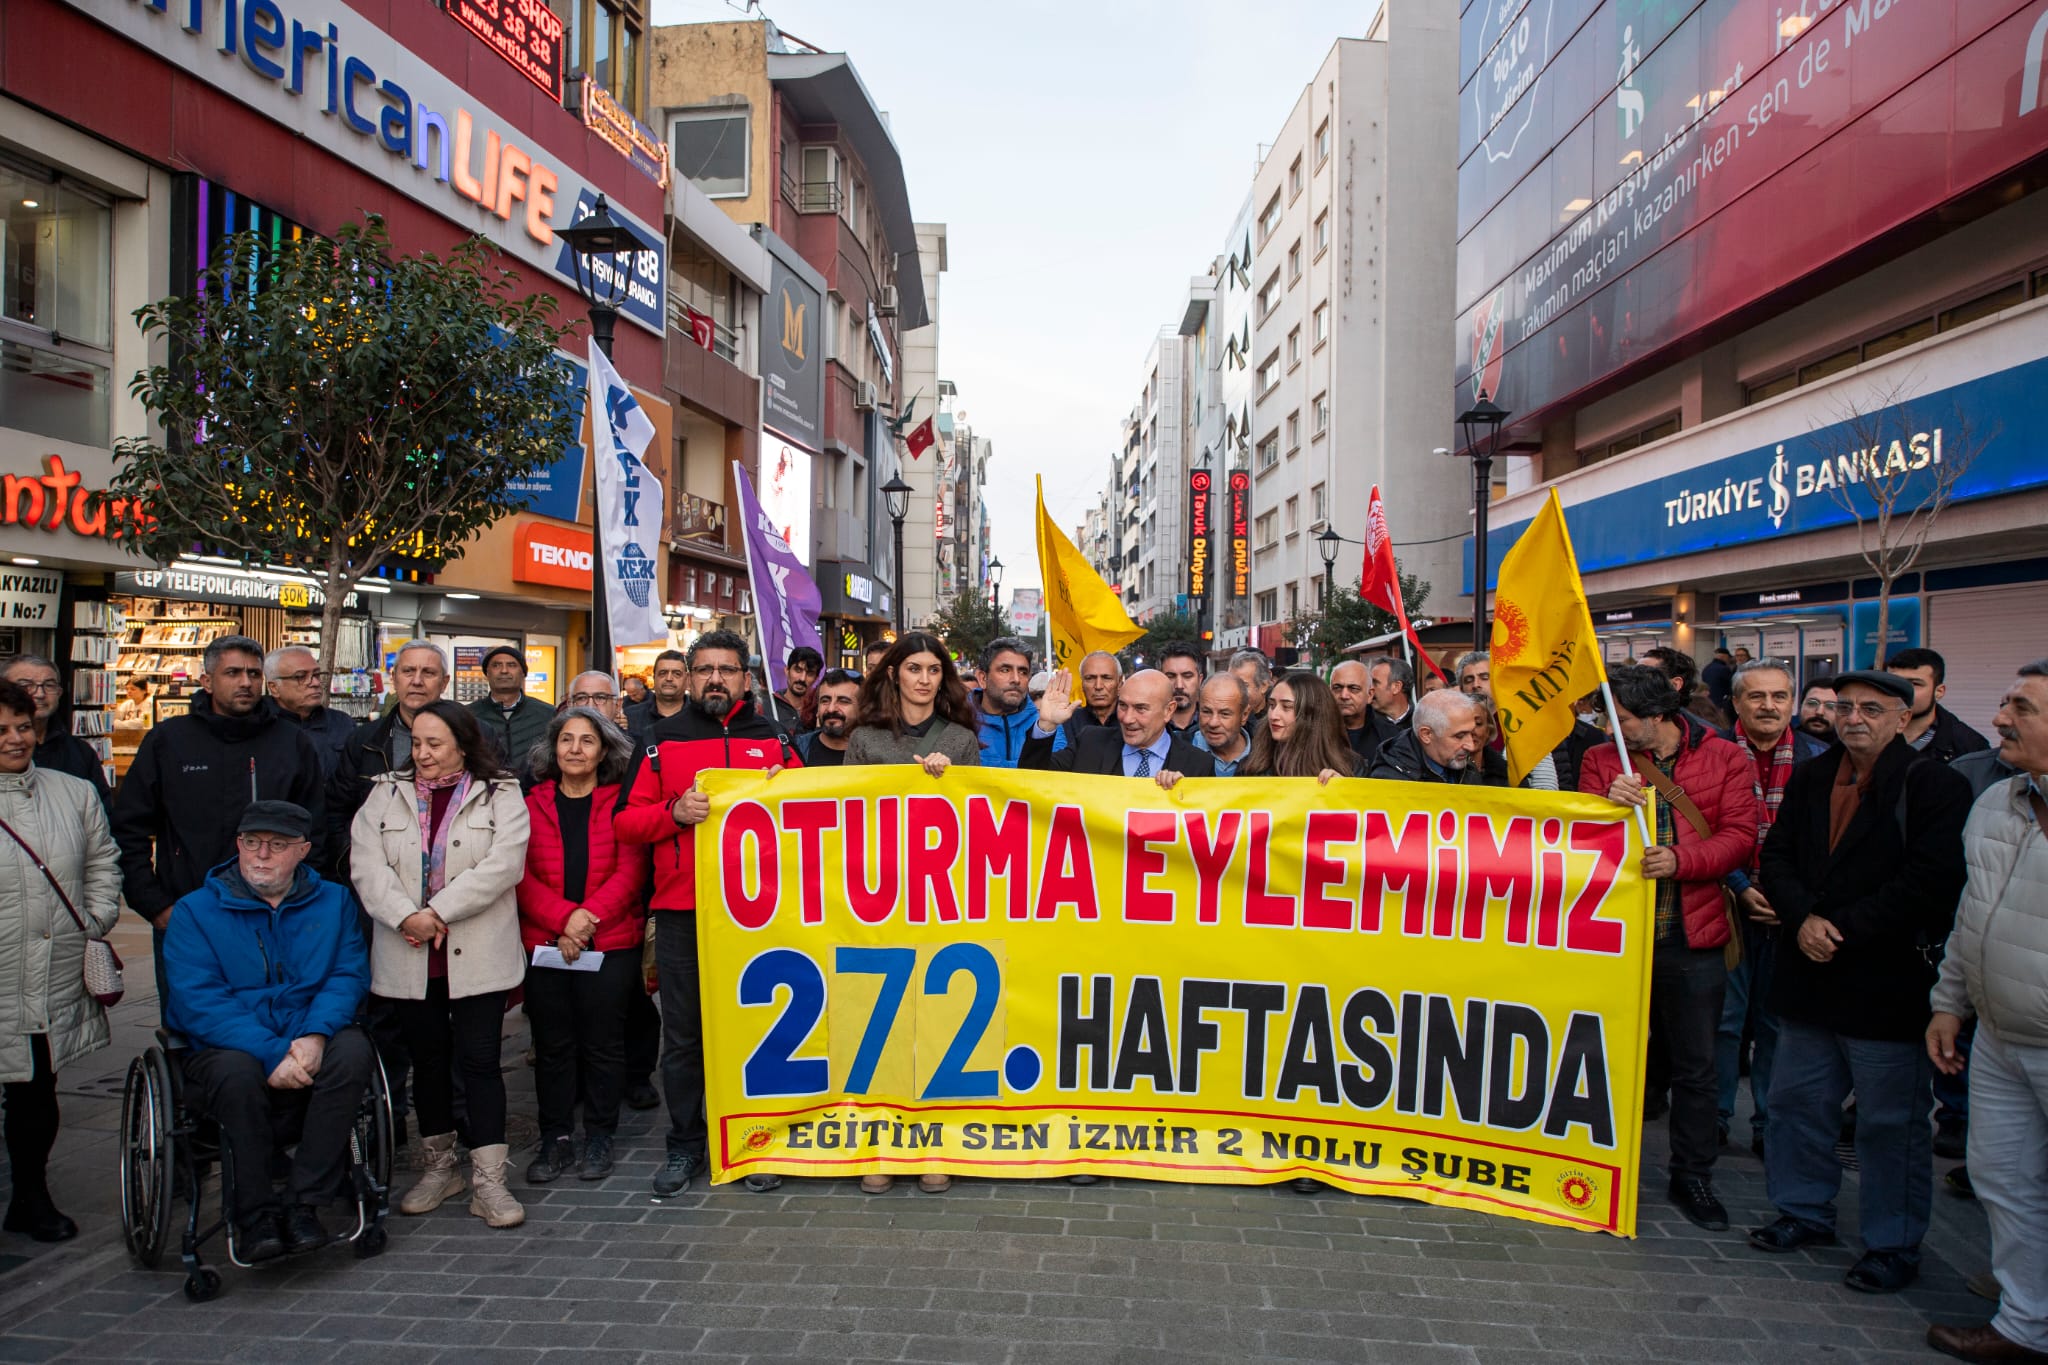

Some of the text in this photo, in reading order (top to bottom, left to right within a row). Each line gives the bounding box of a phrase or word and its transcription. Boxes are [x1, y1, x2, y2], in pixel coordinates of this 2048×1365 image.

[502, 6, 526, 44] 38
[530, 30, 551, 65] 38
[518, 0, 561, 43] SHOP
[1494, 17, 1530, 94] %10
[1521, 283, 1569, 341] takımın
[1572, 225, 1629, 296] maçları
[1634, 124, 1739, 241] kazanırken
[1747, 77, 1788, 137] sen
[1798, 38, 1831, 89] de
[1524, 216, 1592, 298] Maximum
[1192, 492, 1208, 536] Tavuk
[1664, 478, 1764, 528] TÜRKİYE
[1796, 428, 1942, 497] BANKASI
[13, 603, 47, 620] No:7
[167, 572, 279, 601] TELEFONLARINDA
[721, 794, 1100, 931] OTURMA
[737, 941, 1618, 1151] 272. HAFTASINDA
[786, 1111, 1531, 1195] EĞİTİM SEN İZMİR 2 NOLU ŞUBE
